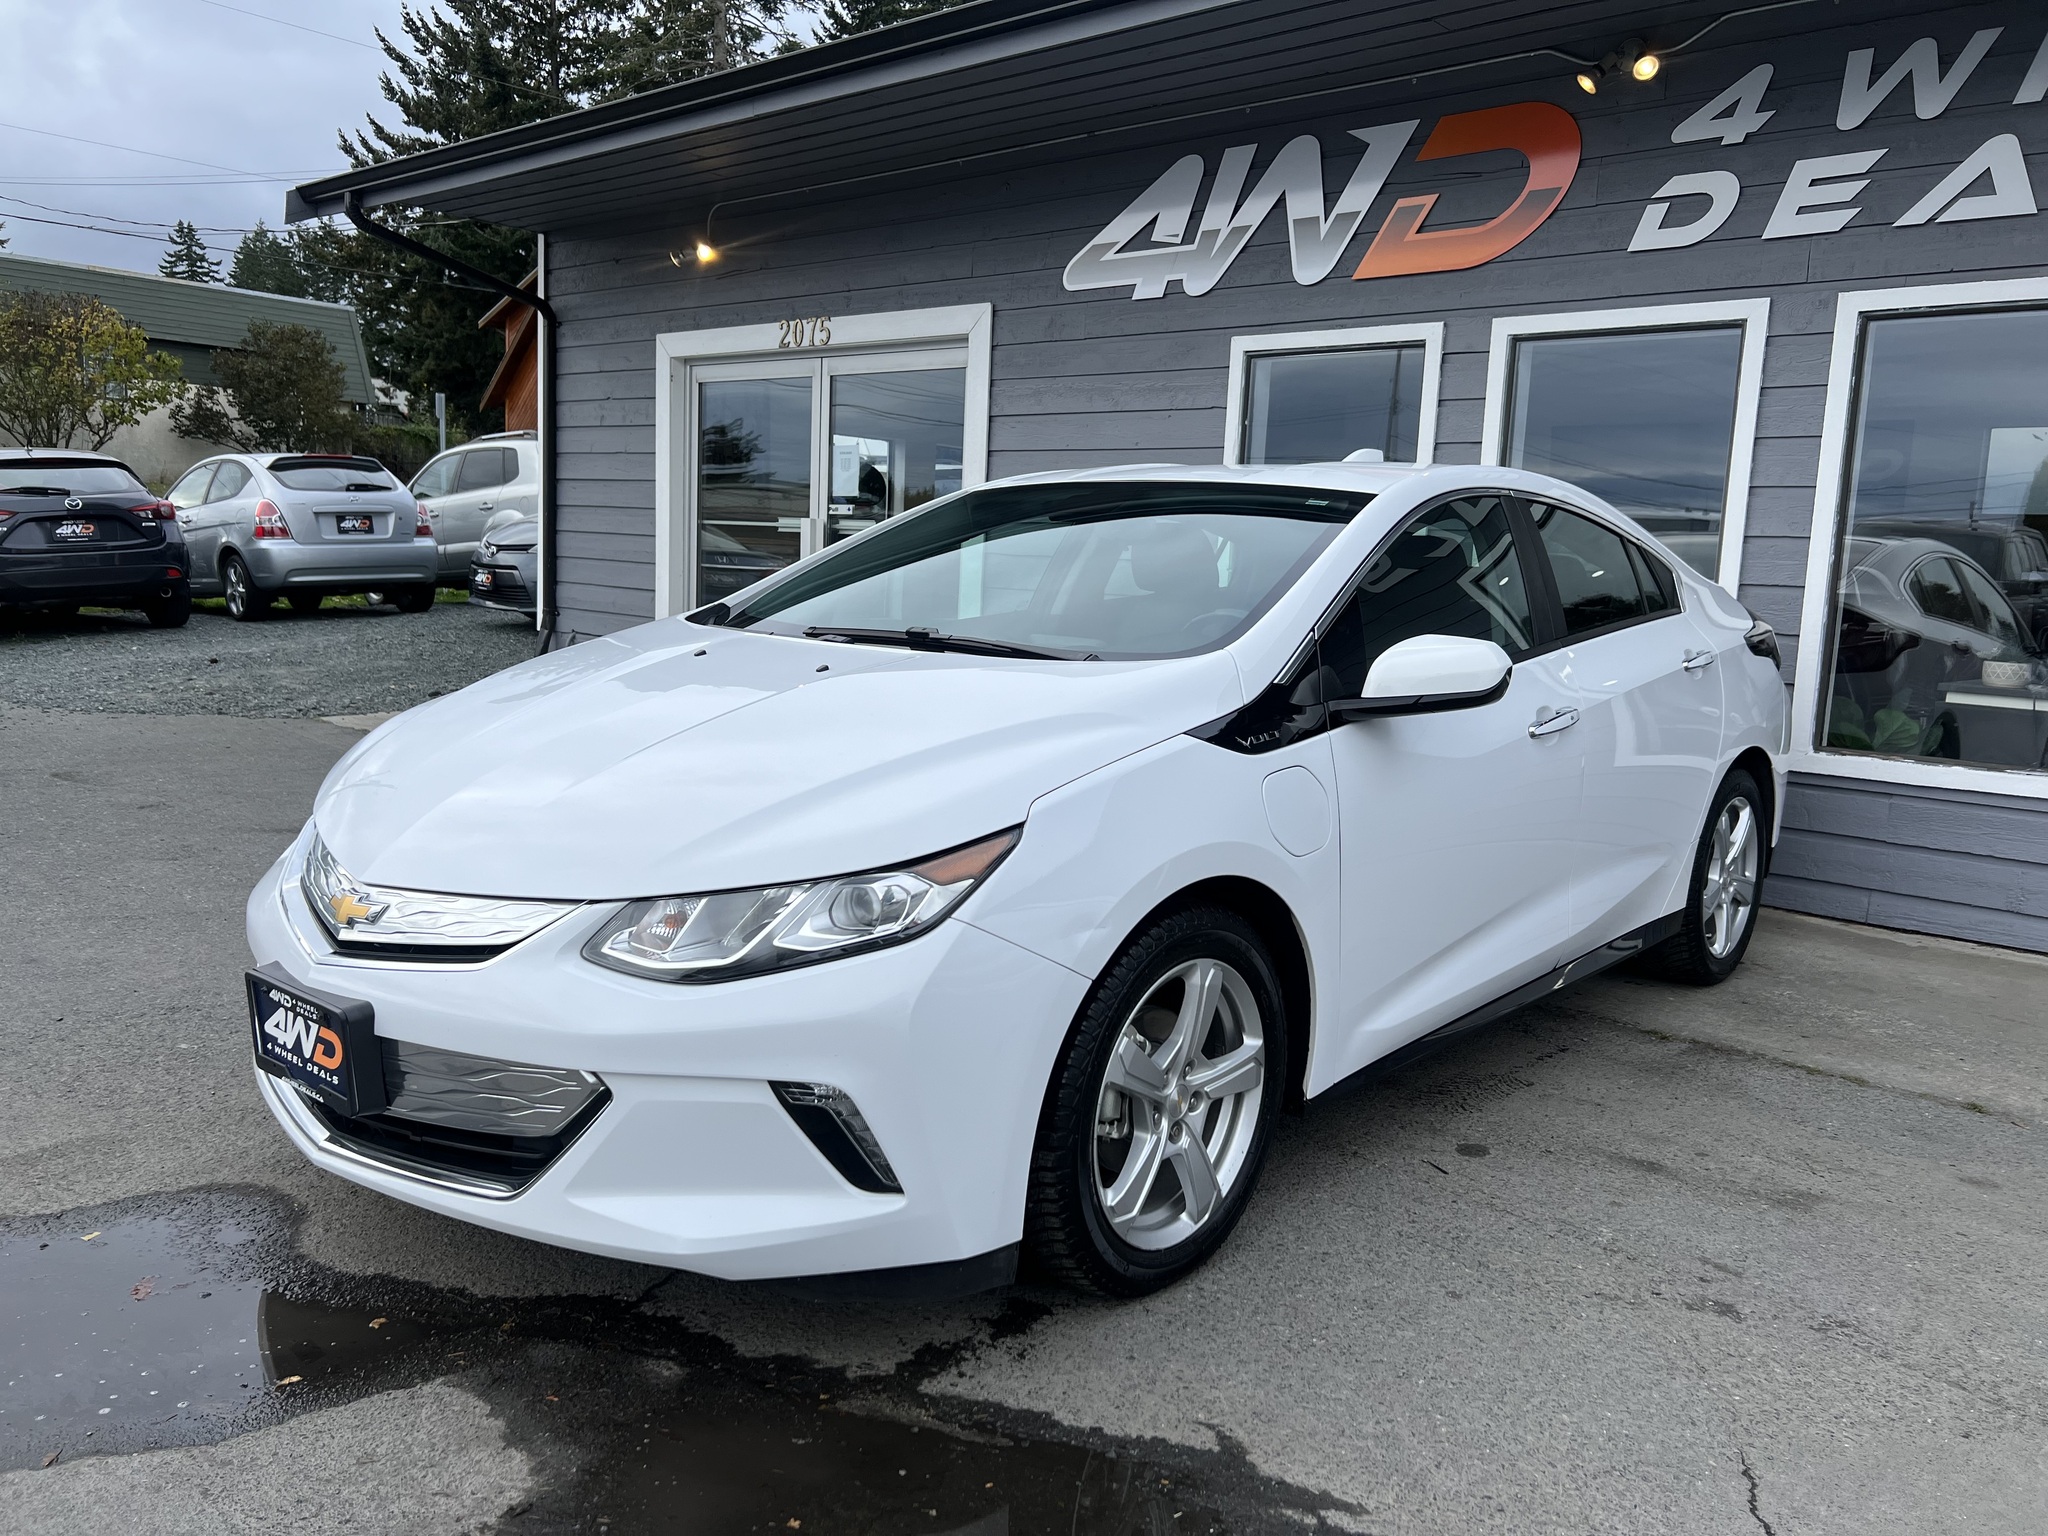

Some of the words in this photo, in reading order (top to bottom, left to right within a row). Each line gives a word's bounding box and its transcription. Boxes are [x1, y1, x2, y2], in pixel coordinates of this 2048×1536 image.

[1671, 64, 1776, 145] 4
[1063, 101, 1582, 301] 4WD
[1627, 134, 2038, 252] DEA
[779, 316, 831, 349] 2075
[55, 524, 95, 534] 4WD
[1235, 730, 1280, 748] VOLT
[269, 989, 292, 1008] 4WD
[296, 1006, 318, 1020] DEALS
[297, 1001, 318, 1014] WHEEL
[264, 1007, 343, 1070] 4WD
[266, 1042, 273, 1051] 4
[274, 1045, 303, 1068] WHEEL
[306, 1062, 339, 1086] DEALS
